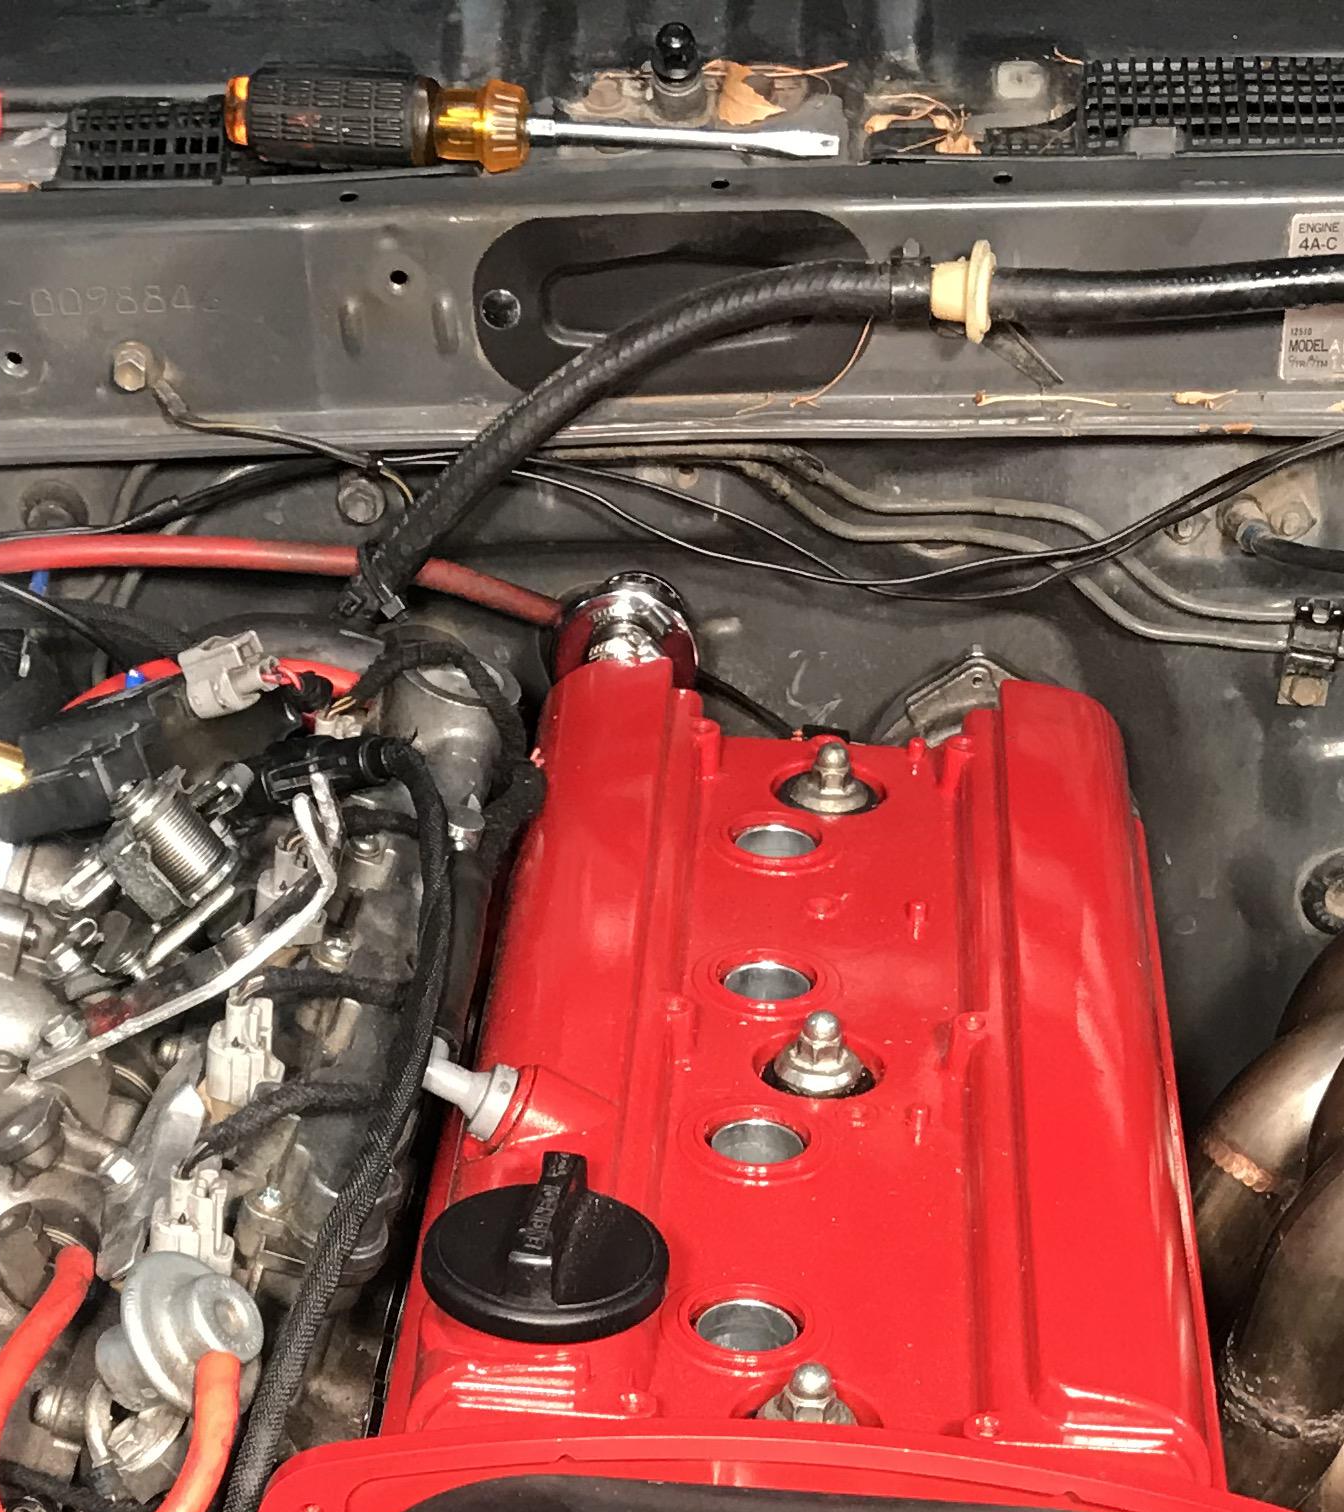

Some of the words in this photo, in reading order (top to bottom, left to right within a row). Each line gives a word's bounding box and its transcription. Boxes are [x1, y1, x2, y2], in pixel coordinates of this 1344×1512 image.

[1298, 221, 1340, 233] ENGINE
[1298, 237, 1338, 251] 4A-C
[1288, 339, 1328, 353] MODEL
